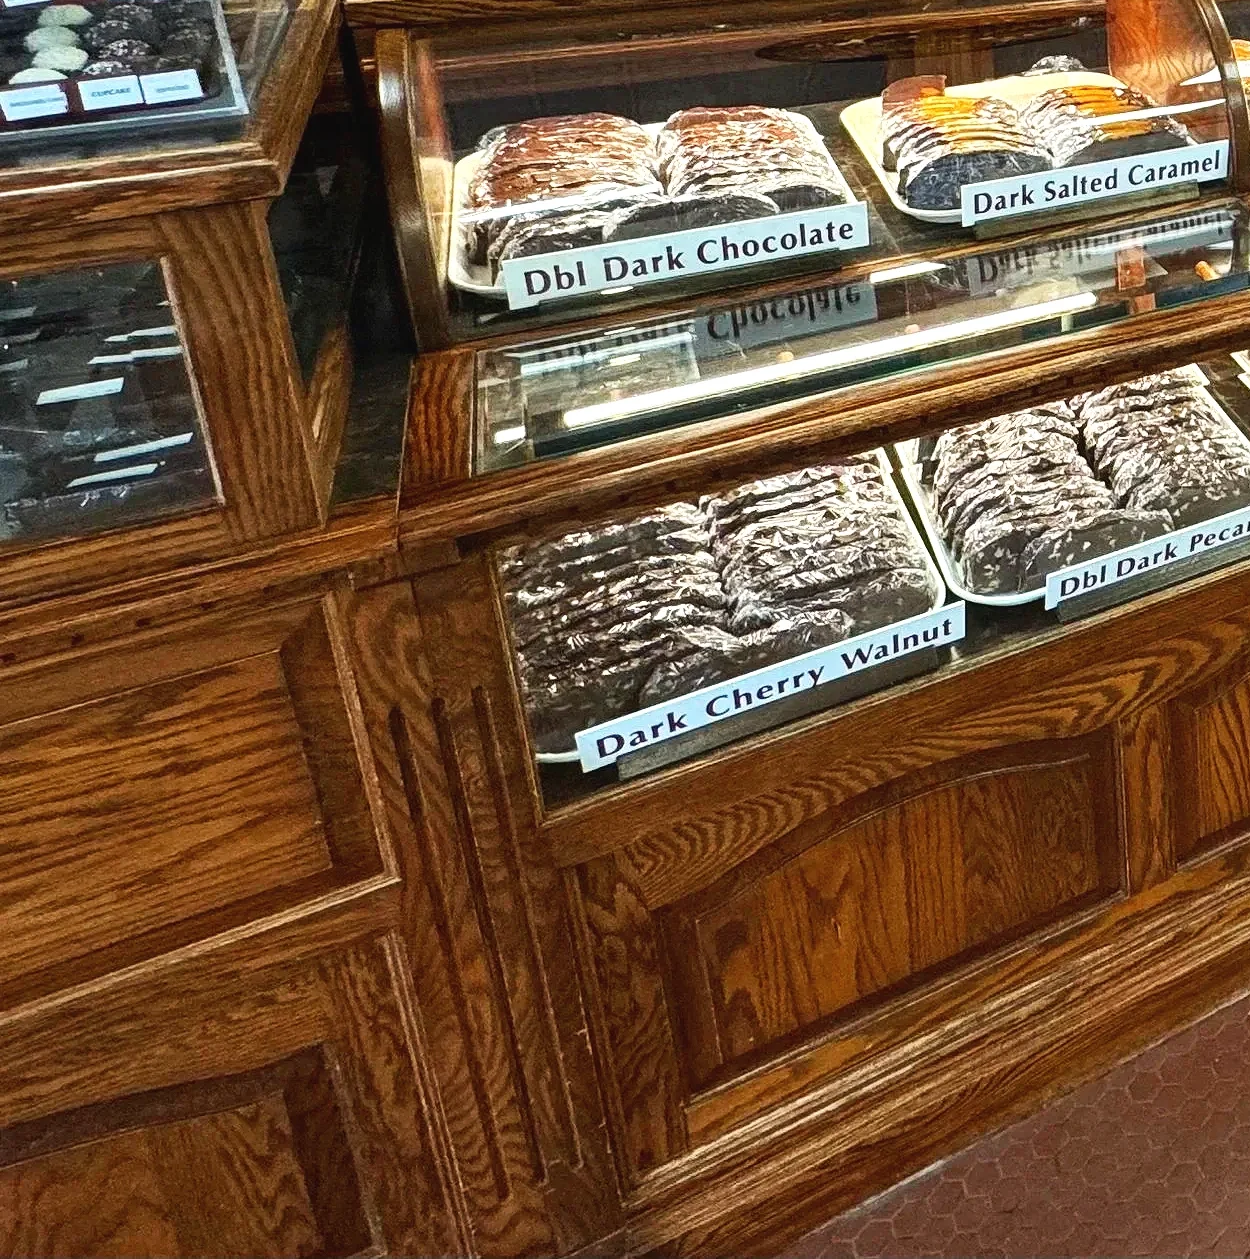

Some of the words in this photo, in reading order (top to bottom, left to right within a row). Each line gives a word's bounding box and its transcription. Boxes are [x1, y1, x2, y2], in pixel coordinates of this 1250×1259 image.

[974, 185, 1034, 214] Dark
[1045, 168, 1118, 201] Salted
[1128, 150, 1220, 184] Caramel
[524, 260, 586, 296] Dbl
[604, 245, 686, 282] Dark
[697, 223, 854, 265] Chocolate
[1060, 565, 1106, 597] Dbl
[1116, 543, 1178, 577] Dark
[596, 711, 688, 758] Dark
[706, 665, 824, 717] Cherry
[840, 618, 953, 670] Walnut
